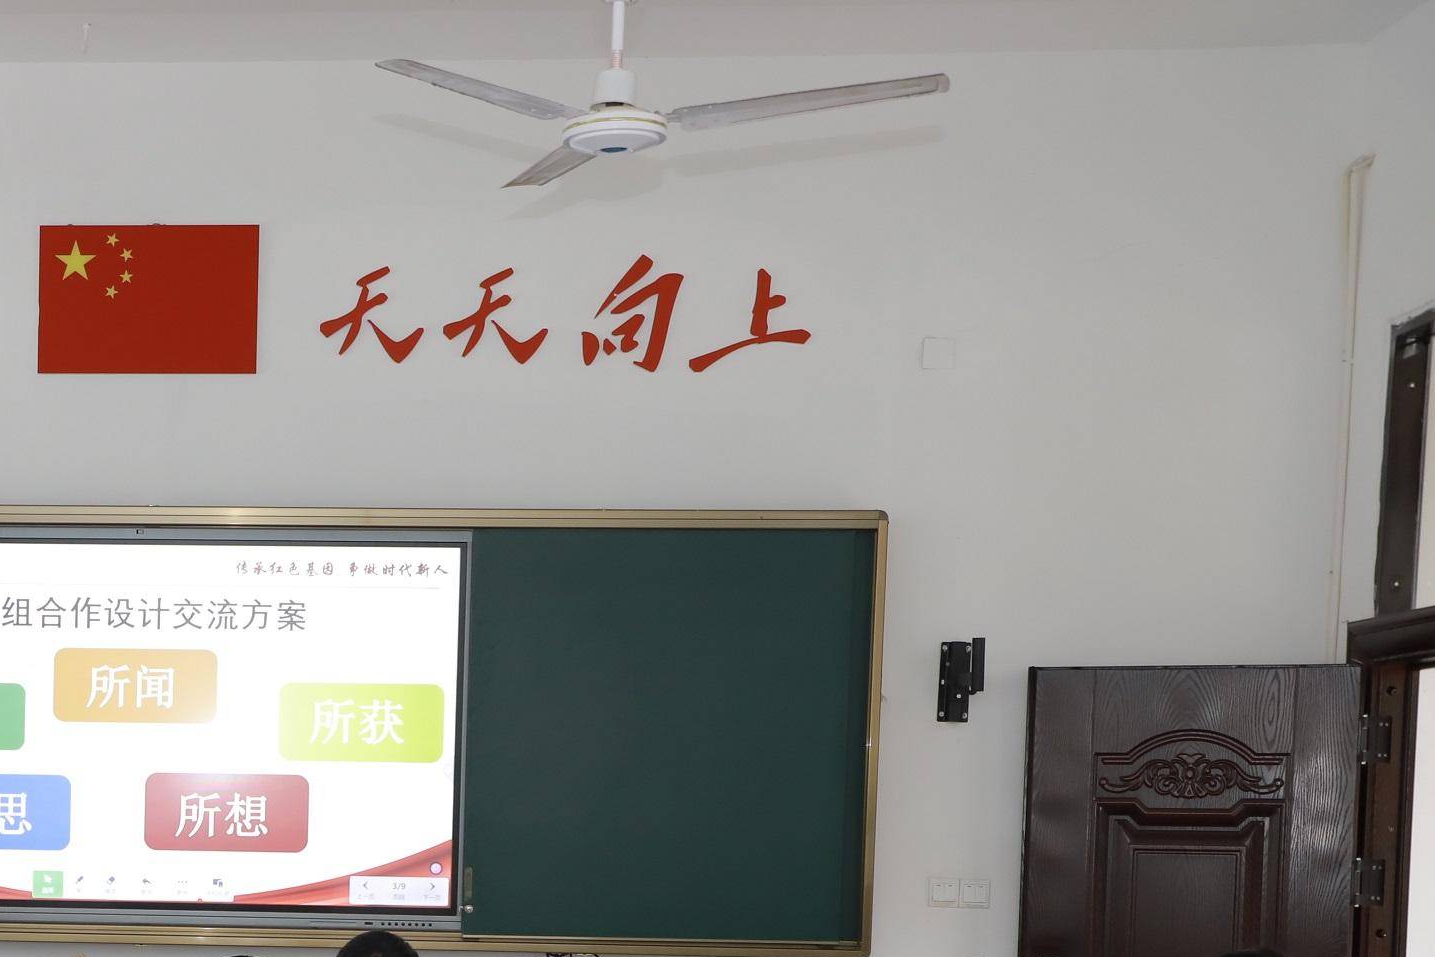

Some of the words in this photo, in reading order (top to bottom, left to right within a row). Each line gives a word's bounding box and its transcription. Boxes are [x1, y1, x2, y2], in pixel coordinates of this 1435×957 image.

[319, 254, 812, 373] 天天向上
[236, 560, 334, 576] 传承红色基因
[85, 665, 175, 710] 所闻
[309, 699, 405, 746] 所获
[174, 792, 270, 840] 所想
